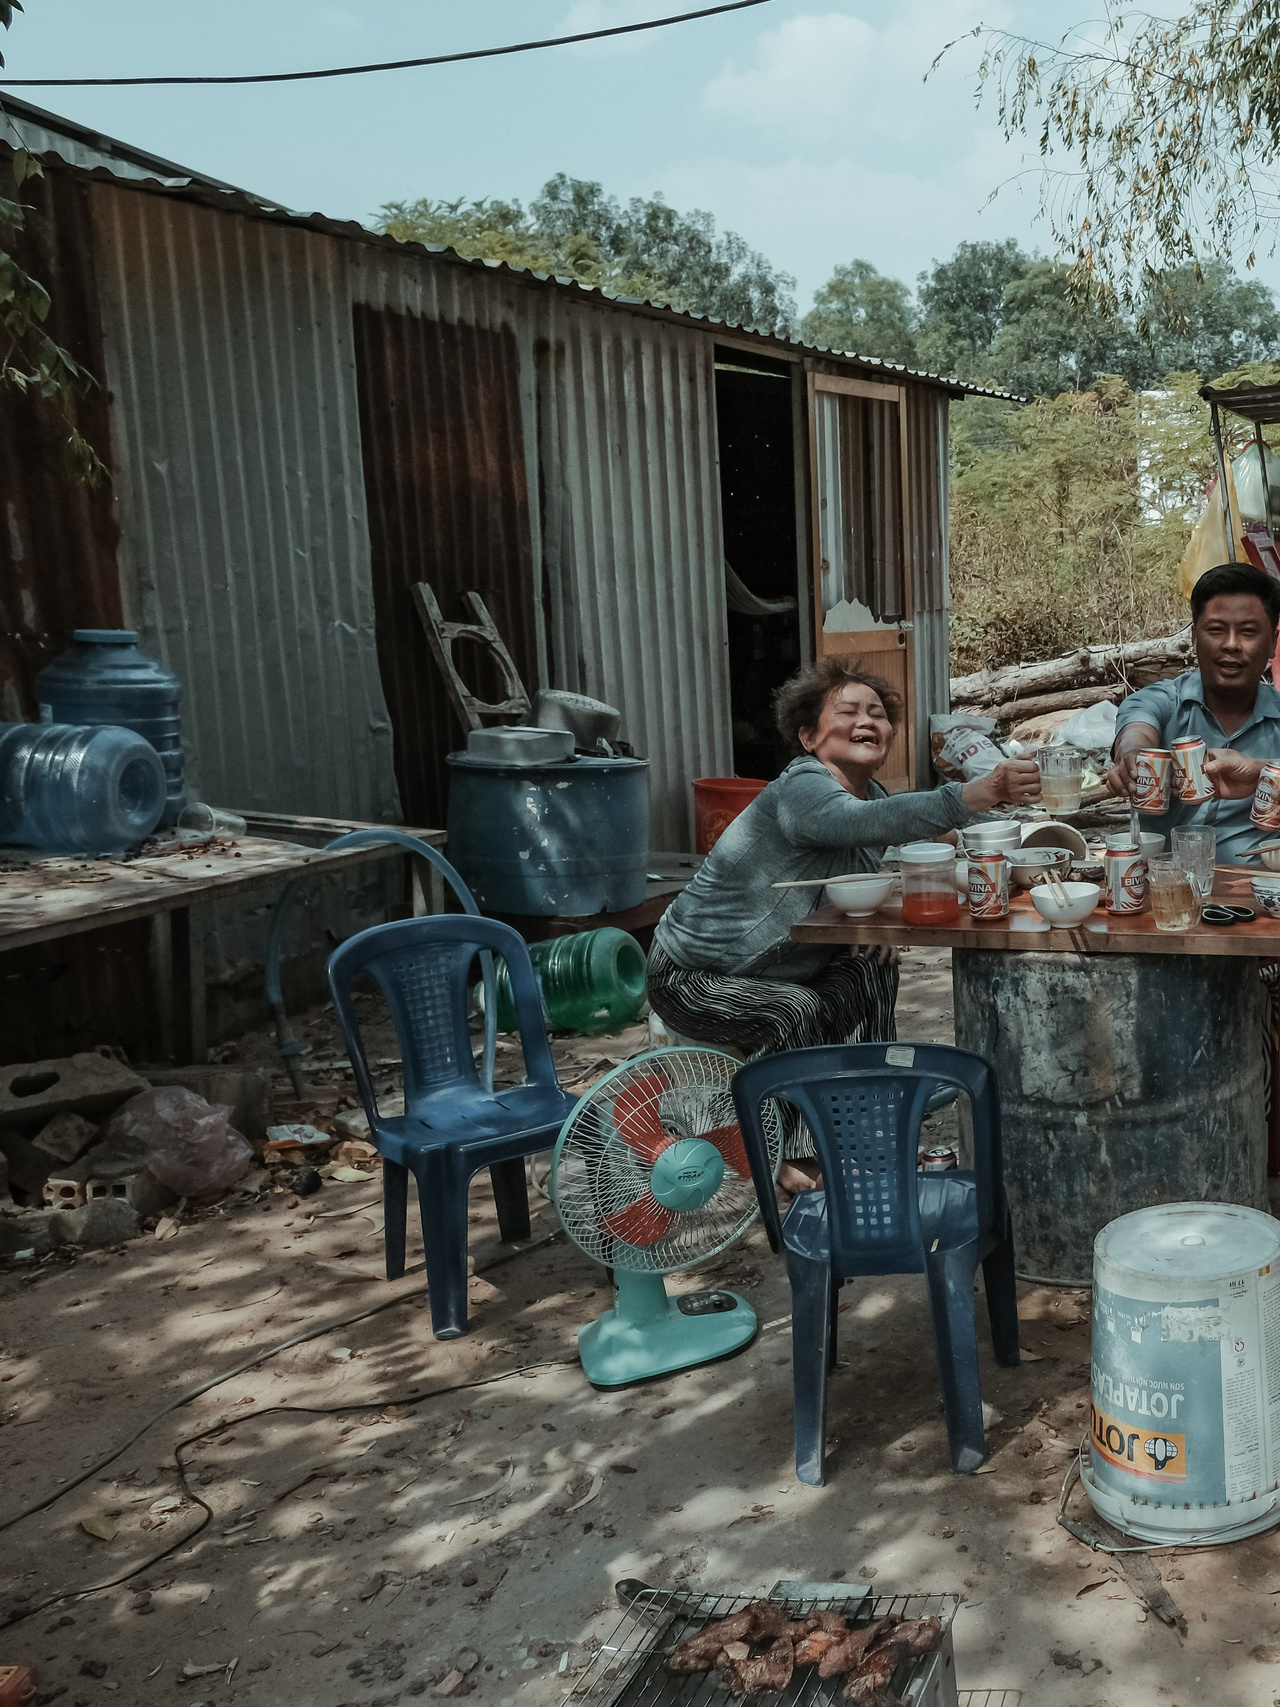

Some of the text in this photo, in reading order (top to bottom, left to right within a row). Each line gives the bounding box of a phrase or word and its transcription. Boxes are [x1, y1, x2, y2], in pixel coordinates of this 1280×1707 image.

[1136, 776, 1156, 786] VINA
[970, 884, 992, 892] VINA
[1091, 1361, 1185, 1419] JOTAPLAS
[1091, 1402, 1140, 1462] JOTU
